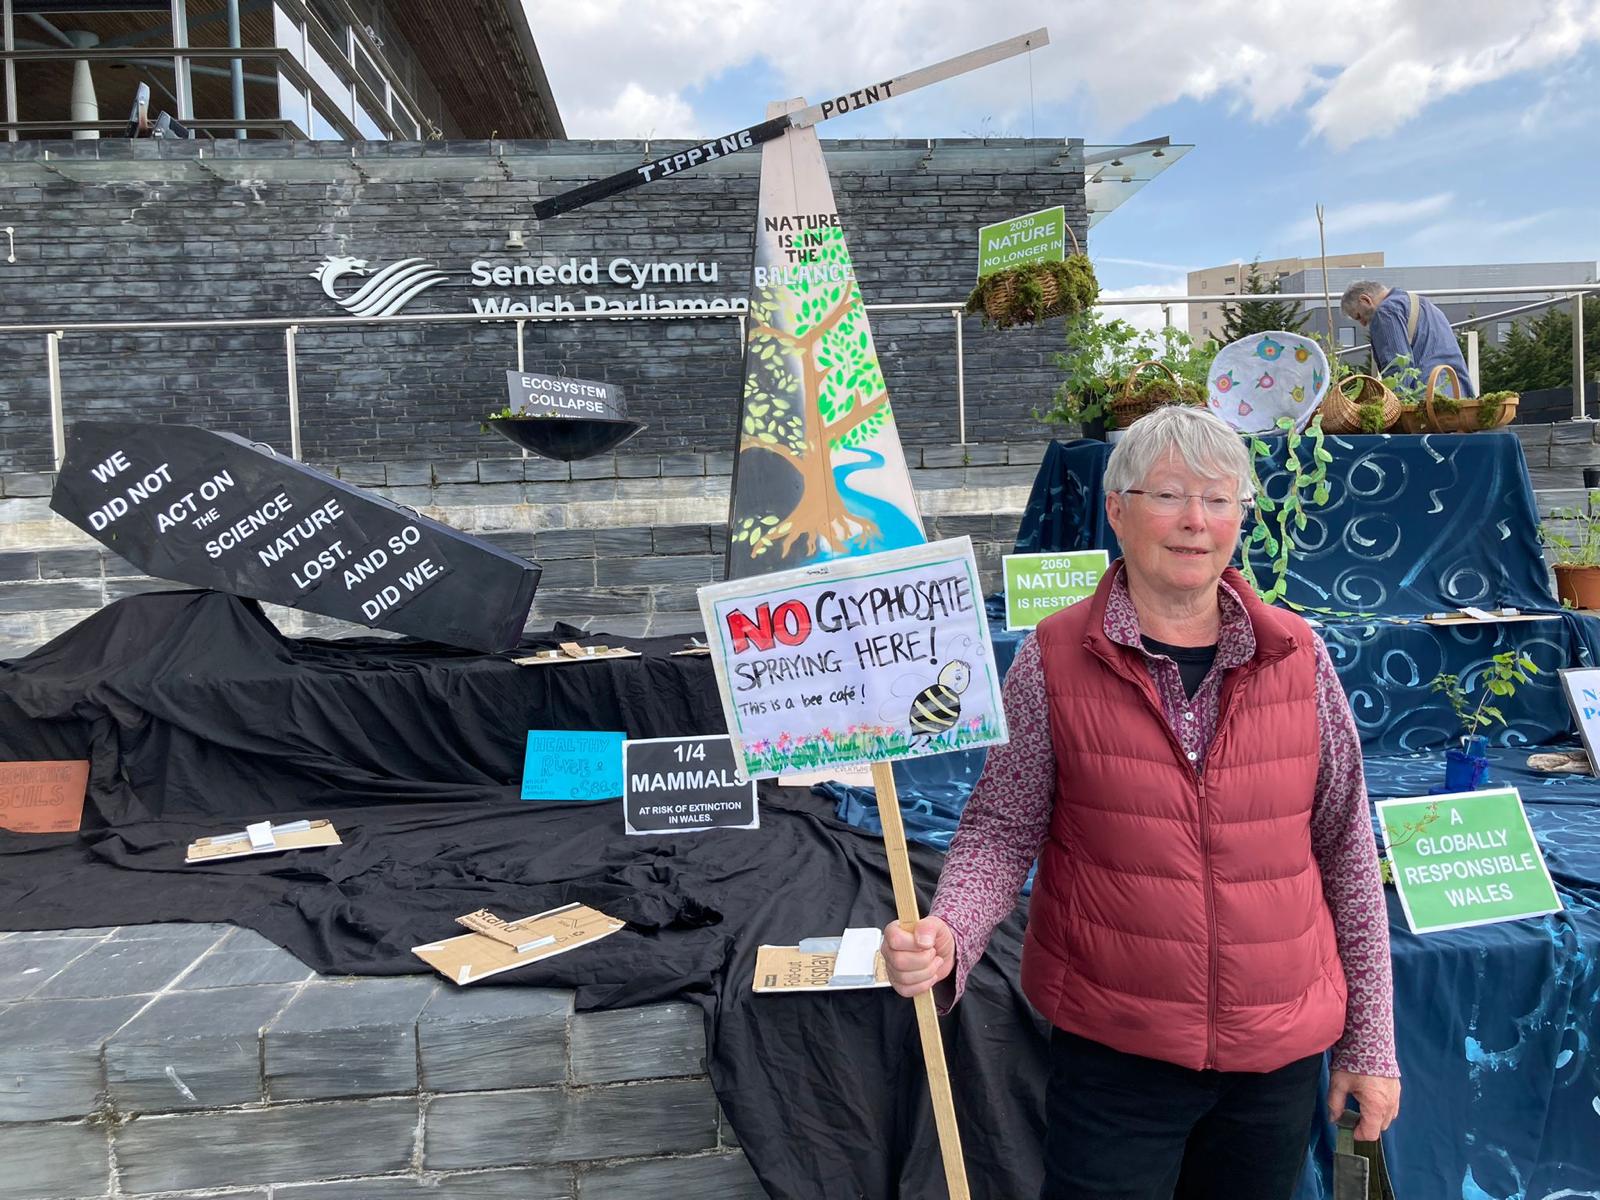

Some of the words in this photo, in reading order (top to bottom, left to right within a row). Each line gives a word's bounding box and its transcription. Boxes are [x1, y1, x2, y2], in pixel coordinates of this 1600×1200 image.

[637, 130, 753, 183] TIPPING
[821, 80, 894, 120] POINT
[764, 213, 841, 233] NATURE
[1010, 217, 1035, 232] 2030
[778, 234, 793, 249] IS
[804, 233, 823, 247] IN
[988, 222, 1056, 252] NATURE
[785, 249, 819, 263] THE
[984, 257, 1000, 268] NO
[1003, 243, 1048, 262] LONGER
[1051, 239, 1062, 250] IN
[471, 257, 598, 287] Senedd
[608, 258, 719, 290] Cymru
[754, 263, 856, 288] BALANCE
[471, 295, 576, 323] Welsh
[584, 293, 749, 321] Parliamen
[521, 376, 607, 399] ECOSYSTEM
[529, 393, 604, 413] COLLAPSE
[91, 450, 132, 485] WE
[88, 497, 129, 533] DID
[127, 464, 174, 505] NOT
[156, 492, 199, 534] ACT
[199, 469, 236, 502] ON
[192, 507, 220, 531] THE
[205, 492, 293, 559] SCIENCE
[258, 498, 344, 568] NATURE
[291, 539, 353, 590] LOST.
[342, 547, 388, 591] AND
[391, 524, 421, 557] SO
[1041, 559, 1071, 570] 2050
[361, 586, 401, 622] DID
[399, 558, 445, 593] WE.
[1016, 571, 1098, 590] NATURE
[725, 599, 812, 655] NO
[815, 575, 974, 633] GLYPHOSATE
[1018, 598, 1030, 609] IS
[734, 650, 842, 691] SPRAYING
[855, 626, 939, 670] HERE!
[738, 702, 767, 716] This
[771, 699, 781, 712] is
[785, 698, 795, 709] a
[801, 694, 823, 708] bee
[533, 736, 609, 753] HEALTHY
[673, 743, 706, 762] 1/4
[639, 806, 650, 815] AT
[652, 805, 674, 815] RISK
[675, 804, 688, 813] OF
[689, 801, 742, 812] EXTINCTION
[668, 815, 679, 824] IN
[680, 814, 713, 824] WALES.
[1450, 807, 1463, 826] A
[1416, 828, 1508, 856] GLOBALLY
[1404, 853, 1537, 885] RESPONSIBLE
[1444, 883, 1514, 909] WALES
[803, 954, 835, 986] display
